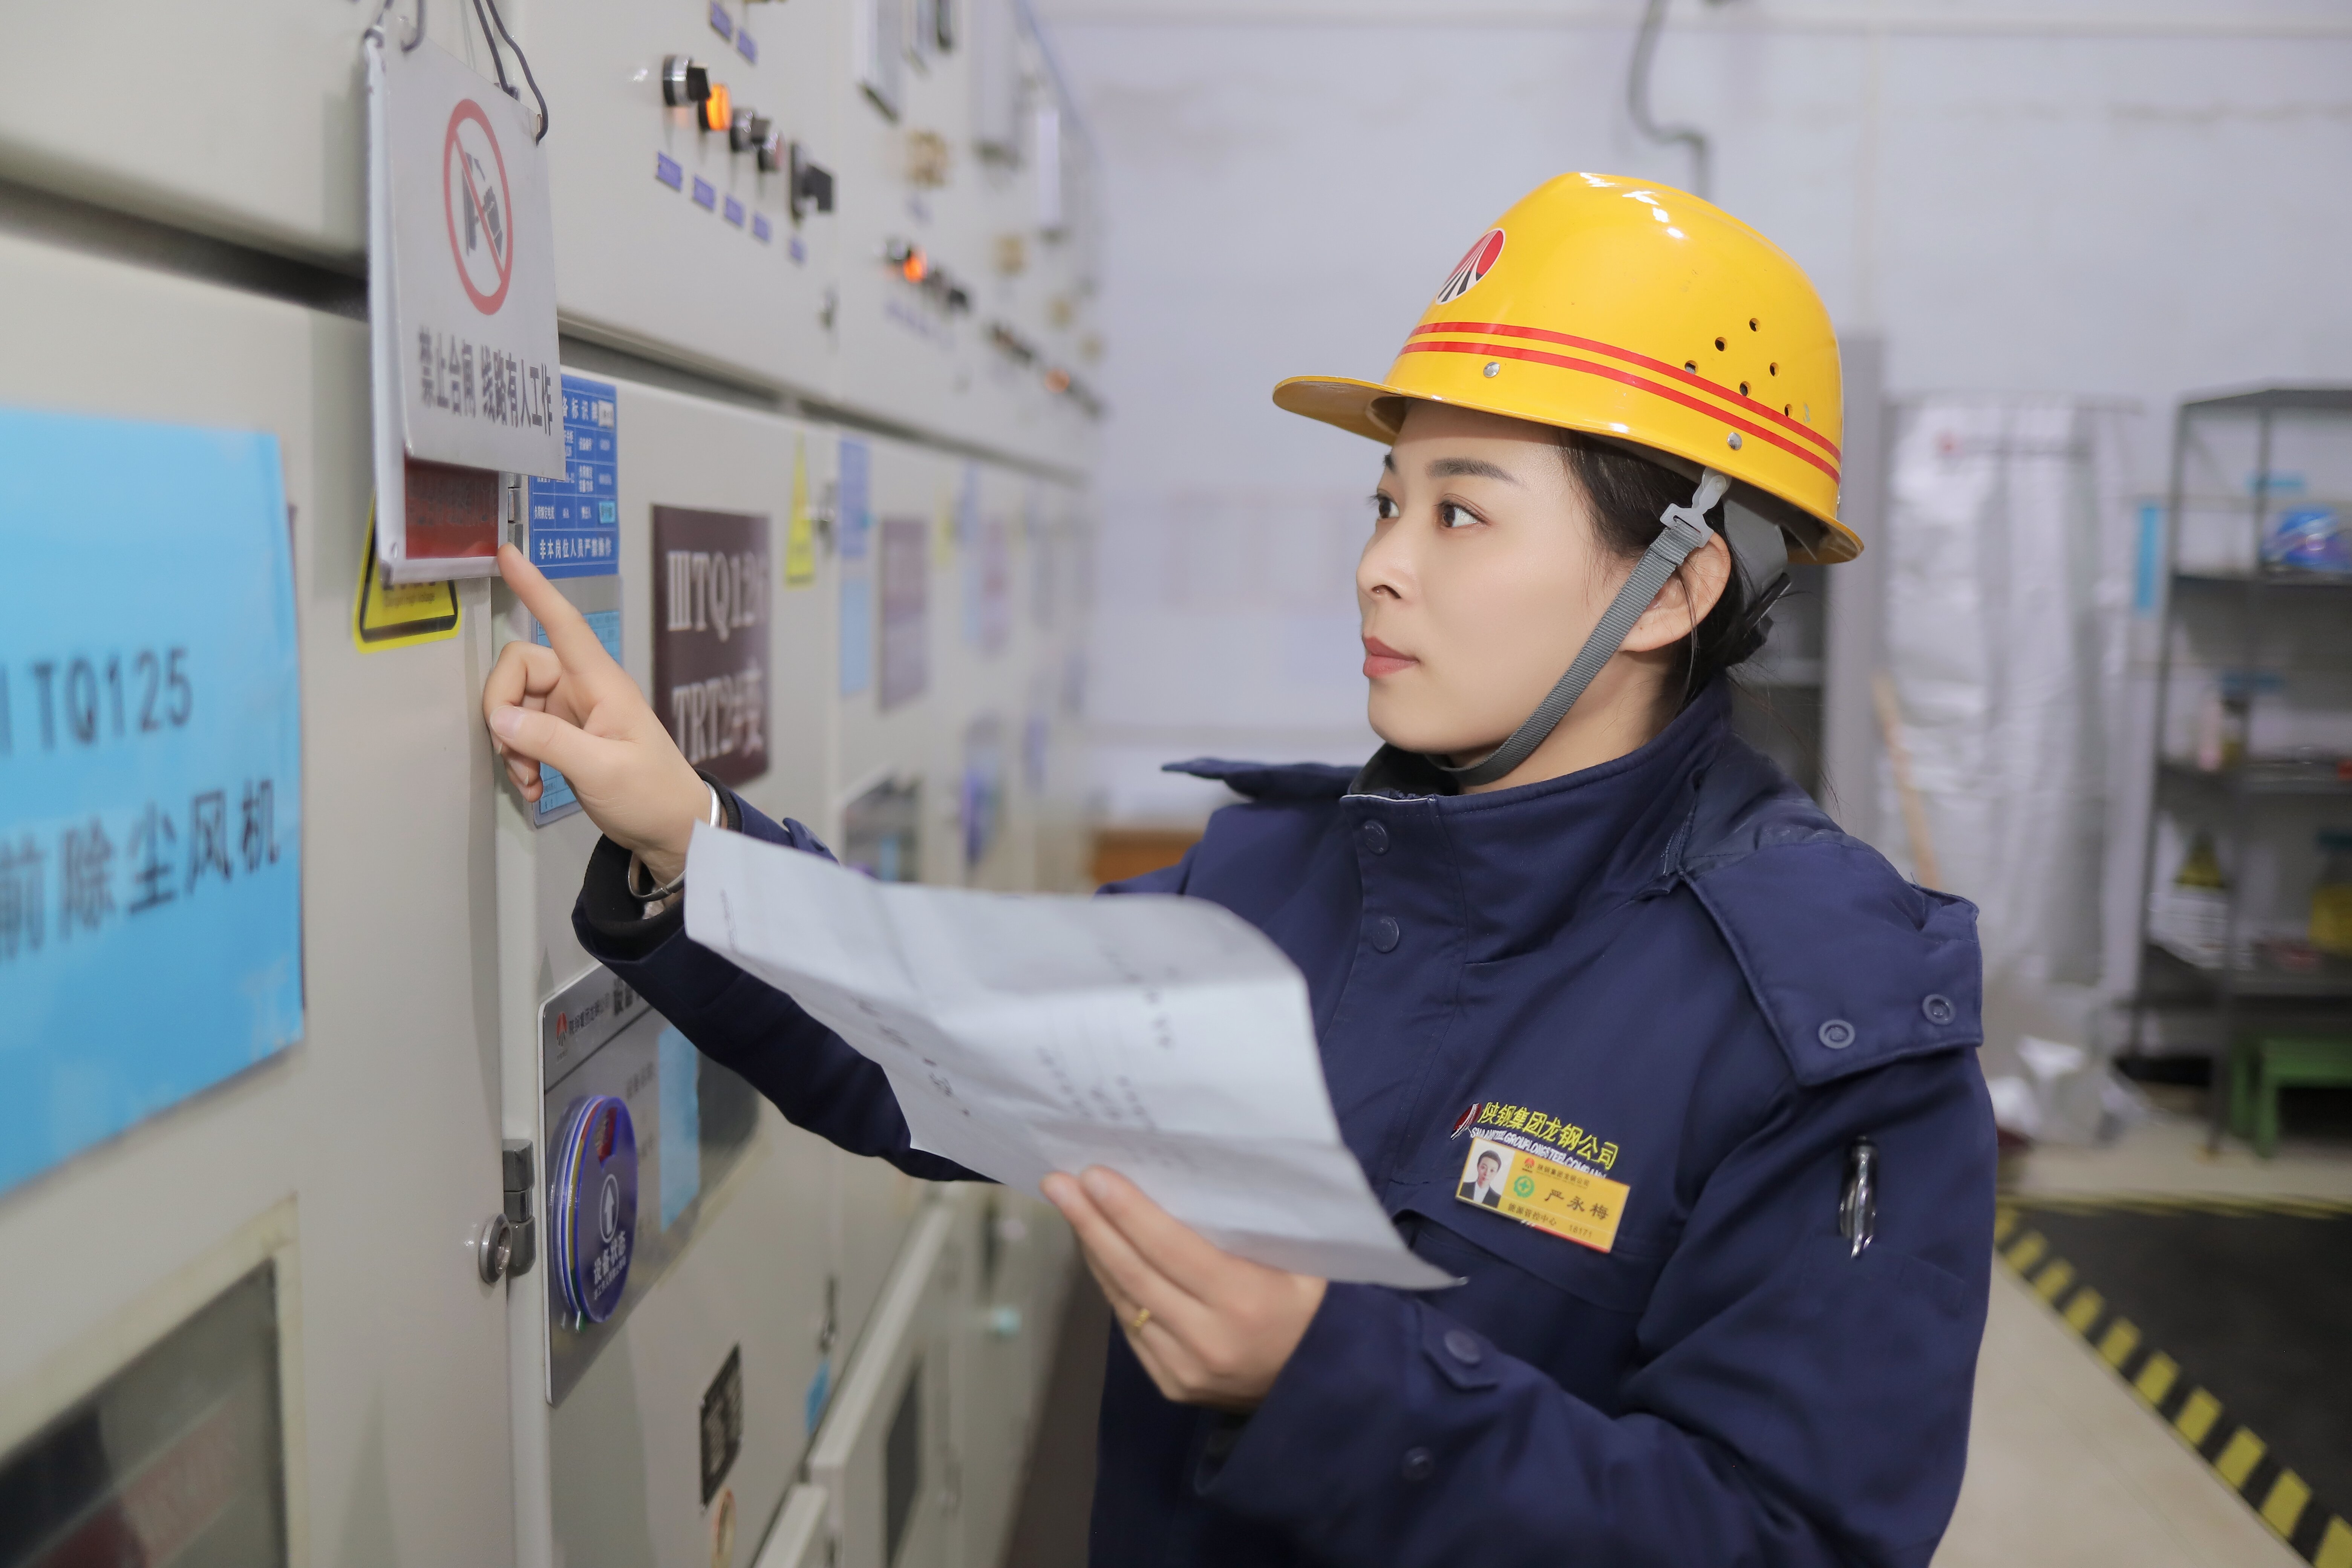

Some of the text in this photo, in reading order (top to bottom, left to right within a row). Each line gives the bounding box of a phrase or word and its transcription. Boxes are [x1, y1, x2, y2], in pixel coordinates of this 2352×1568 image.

[418, 325, 553, 436] 禁止合闸 线路有人工作
[1477, 1101, 1620, 1170] 陕钢集团龙钢公司
[1544, 1189, 1608, 1220] 严永梅
[594, 1230, 626, 1285] 设备状态
